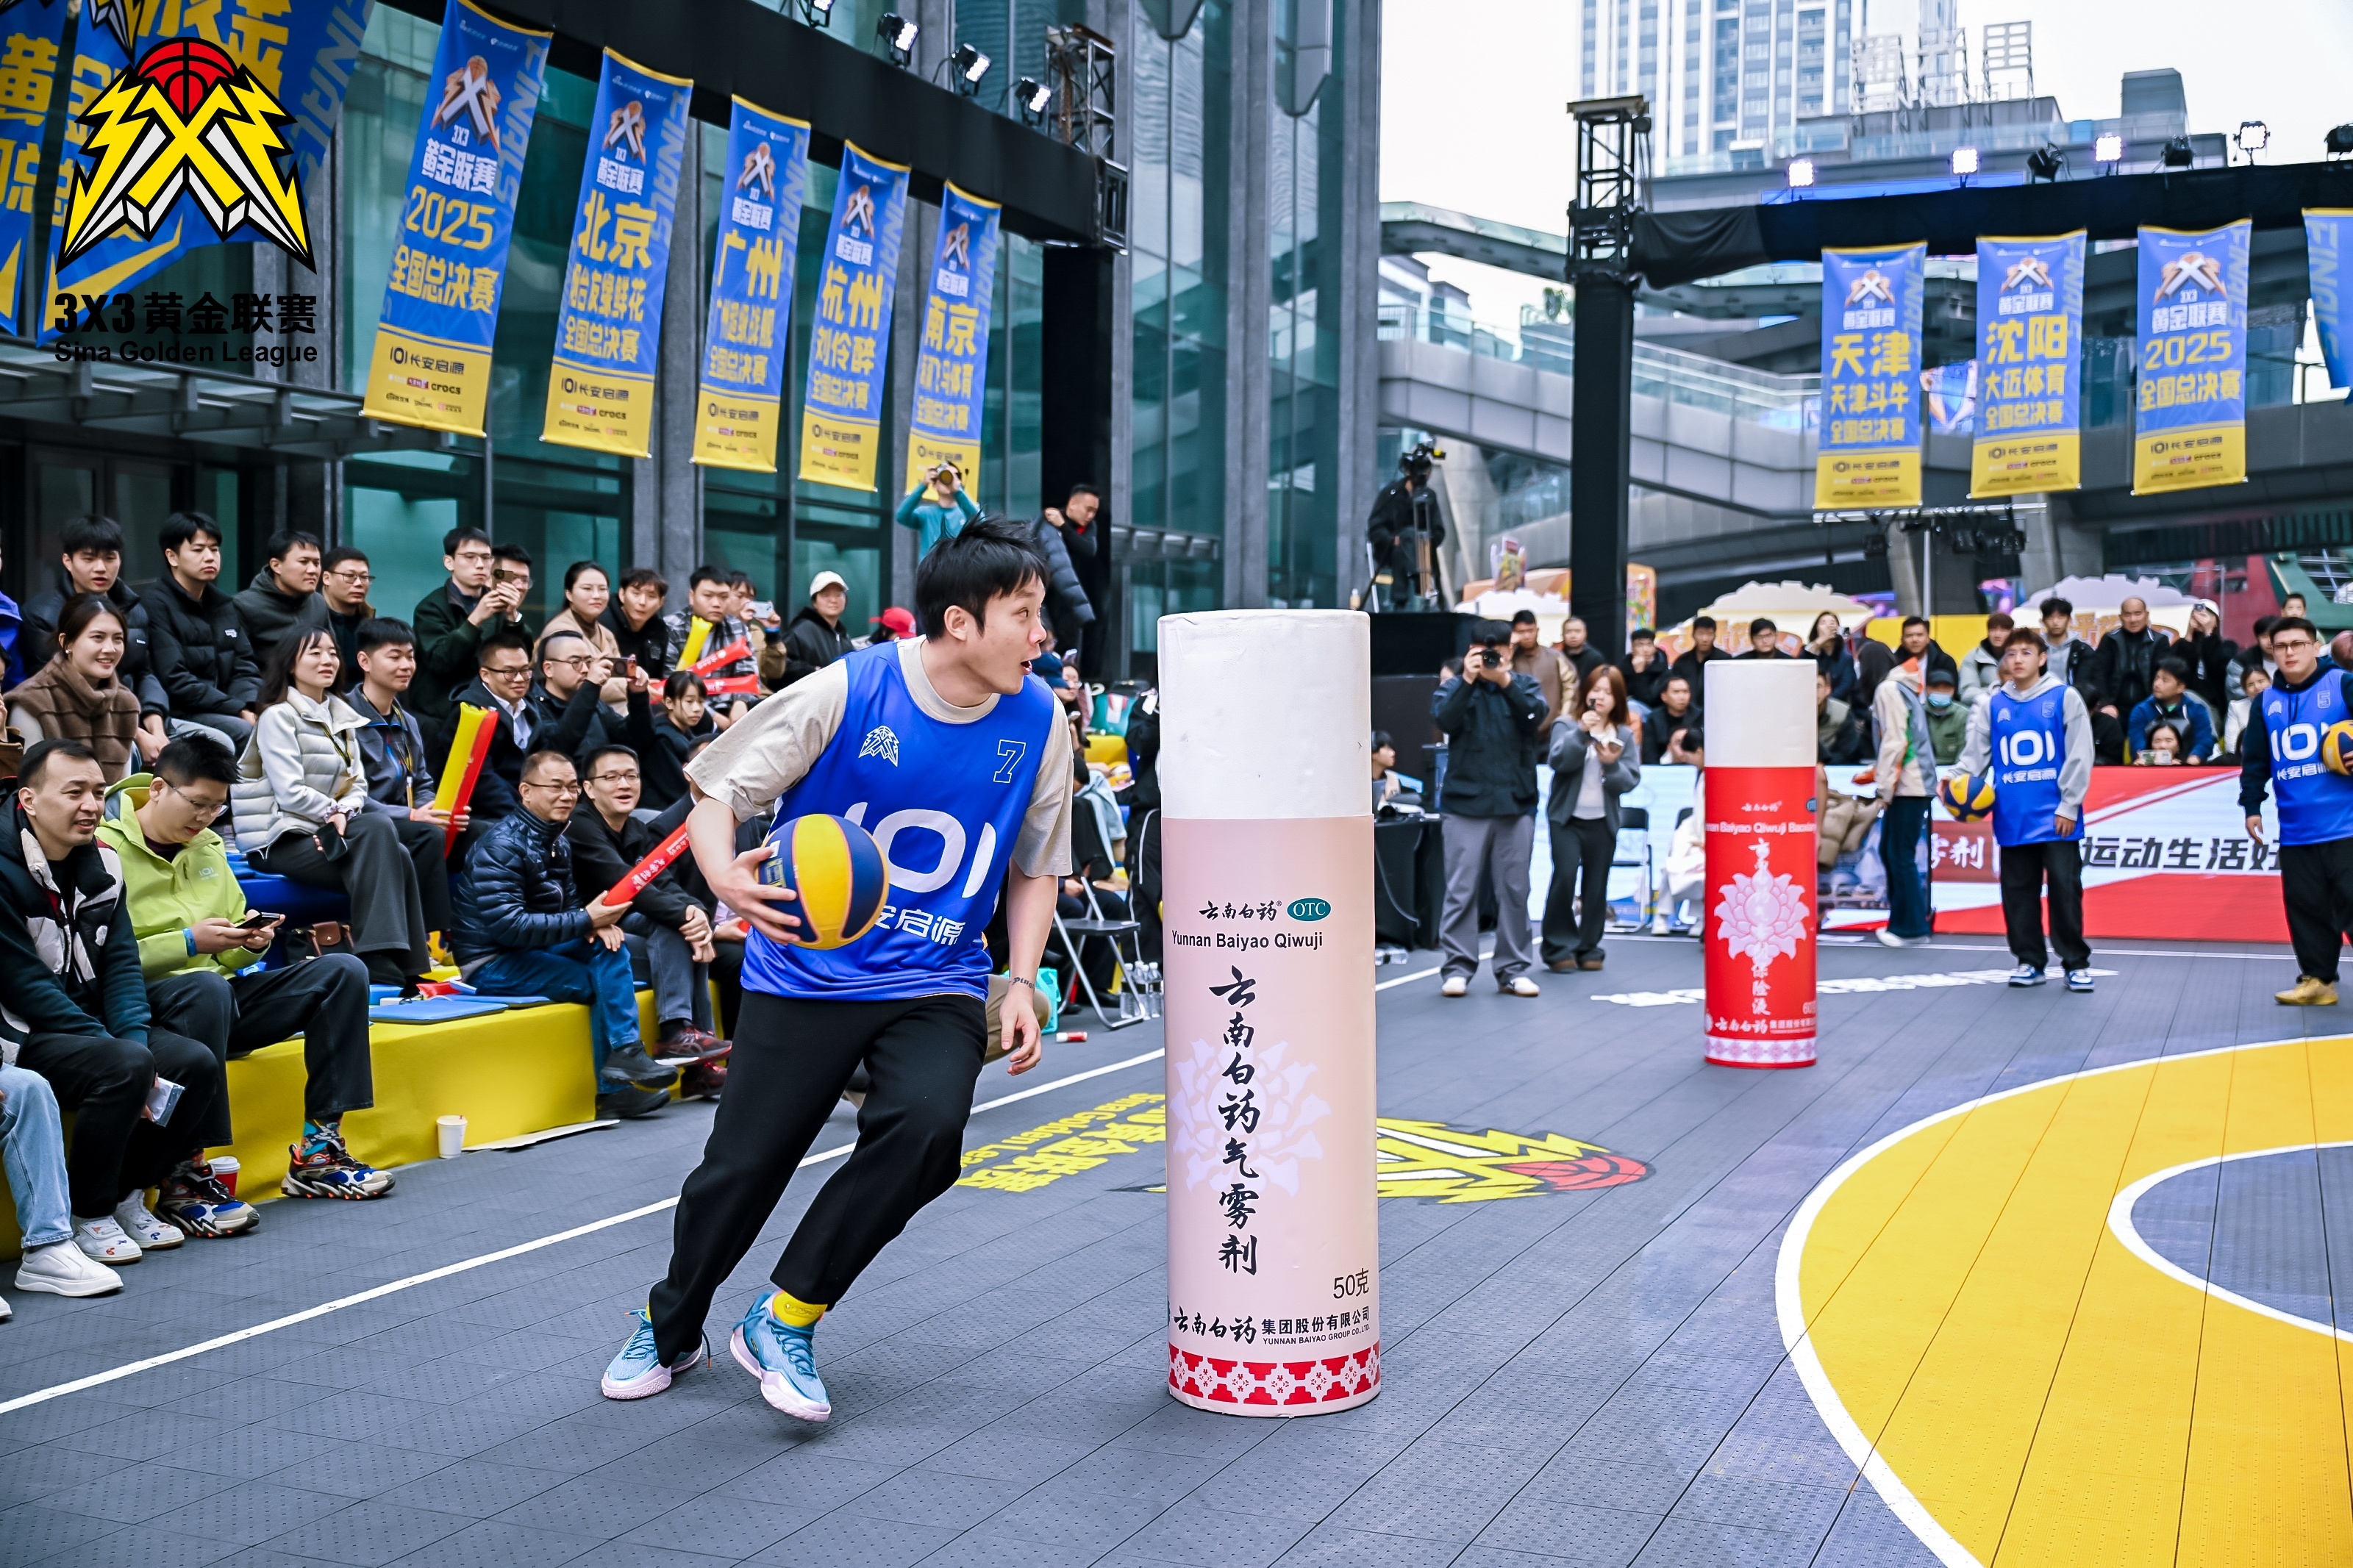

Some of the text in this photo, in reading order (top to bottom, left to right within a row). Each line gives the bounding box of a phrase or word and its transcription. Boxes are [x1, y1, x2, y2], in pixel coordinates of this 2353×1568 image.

[451, 124, 470, 147] 3X3
[421, 137, 497, 196] 黄金联赛
[406, 185, 496, 250] 2025
[577, 189, 657, 268] 北京
[389, 244, 499, 314] 全国总决赛
[717, 229, 782, 300] 广州
[822, 260, 883, 330] 杭州
[924, 295, 979, 356] 南京
[2152, 301, 2227, 334] 黄金联赛
[563, 315, 640, 363] 全国总决赛
[815, 326, 876, 376] 刘伶醉
[1831, 330, 1911, 379] 天津
[1986, 314, 2068, 365] 沈阳
[2144, 332, 2232, 370] 2025
[410, 354, 464, 375] 长安启源
[1985, 363, 2067, 402] 大迈体育
[431, 382, 461, 395] crocs
[579, 384, 629, 401] 长安启源
[1830, 381, 1910, 415] 天津斗牛
[2139, 369, 2242, 412] 全国总决赛
[599, 409, 626, 420] crocs
[1985, 399, 2064, 430] 全国总决赛
[2042, 701, 2056, 718] 5
[2317, 690, 2330, 709] 5
[2000, 730, 2056, 766] 101
[2271, 720, 2329, 762] 10
[993, 739, 1026, 784] 7
[2002, 767, 2057, 784] 长安启源
[1293, 902, 1326, 917] OTC
[1172, 930, 1323, 952] Yunnan Baiyao Qiwuji
[1209, 964, 1261, 1276] 云南白药气雾剂
[1332, 1267, 1370, 1300] 50克
[1173, 1306, 1370, 1345] 云南白药 集团股份有限公司
[1263, 1337, 1296, 1345] YUNNAN
[1299, 1335, 1327, 1345] BAIYAO
[1328, 1331, 1351, 1342] GROUP
